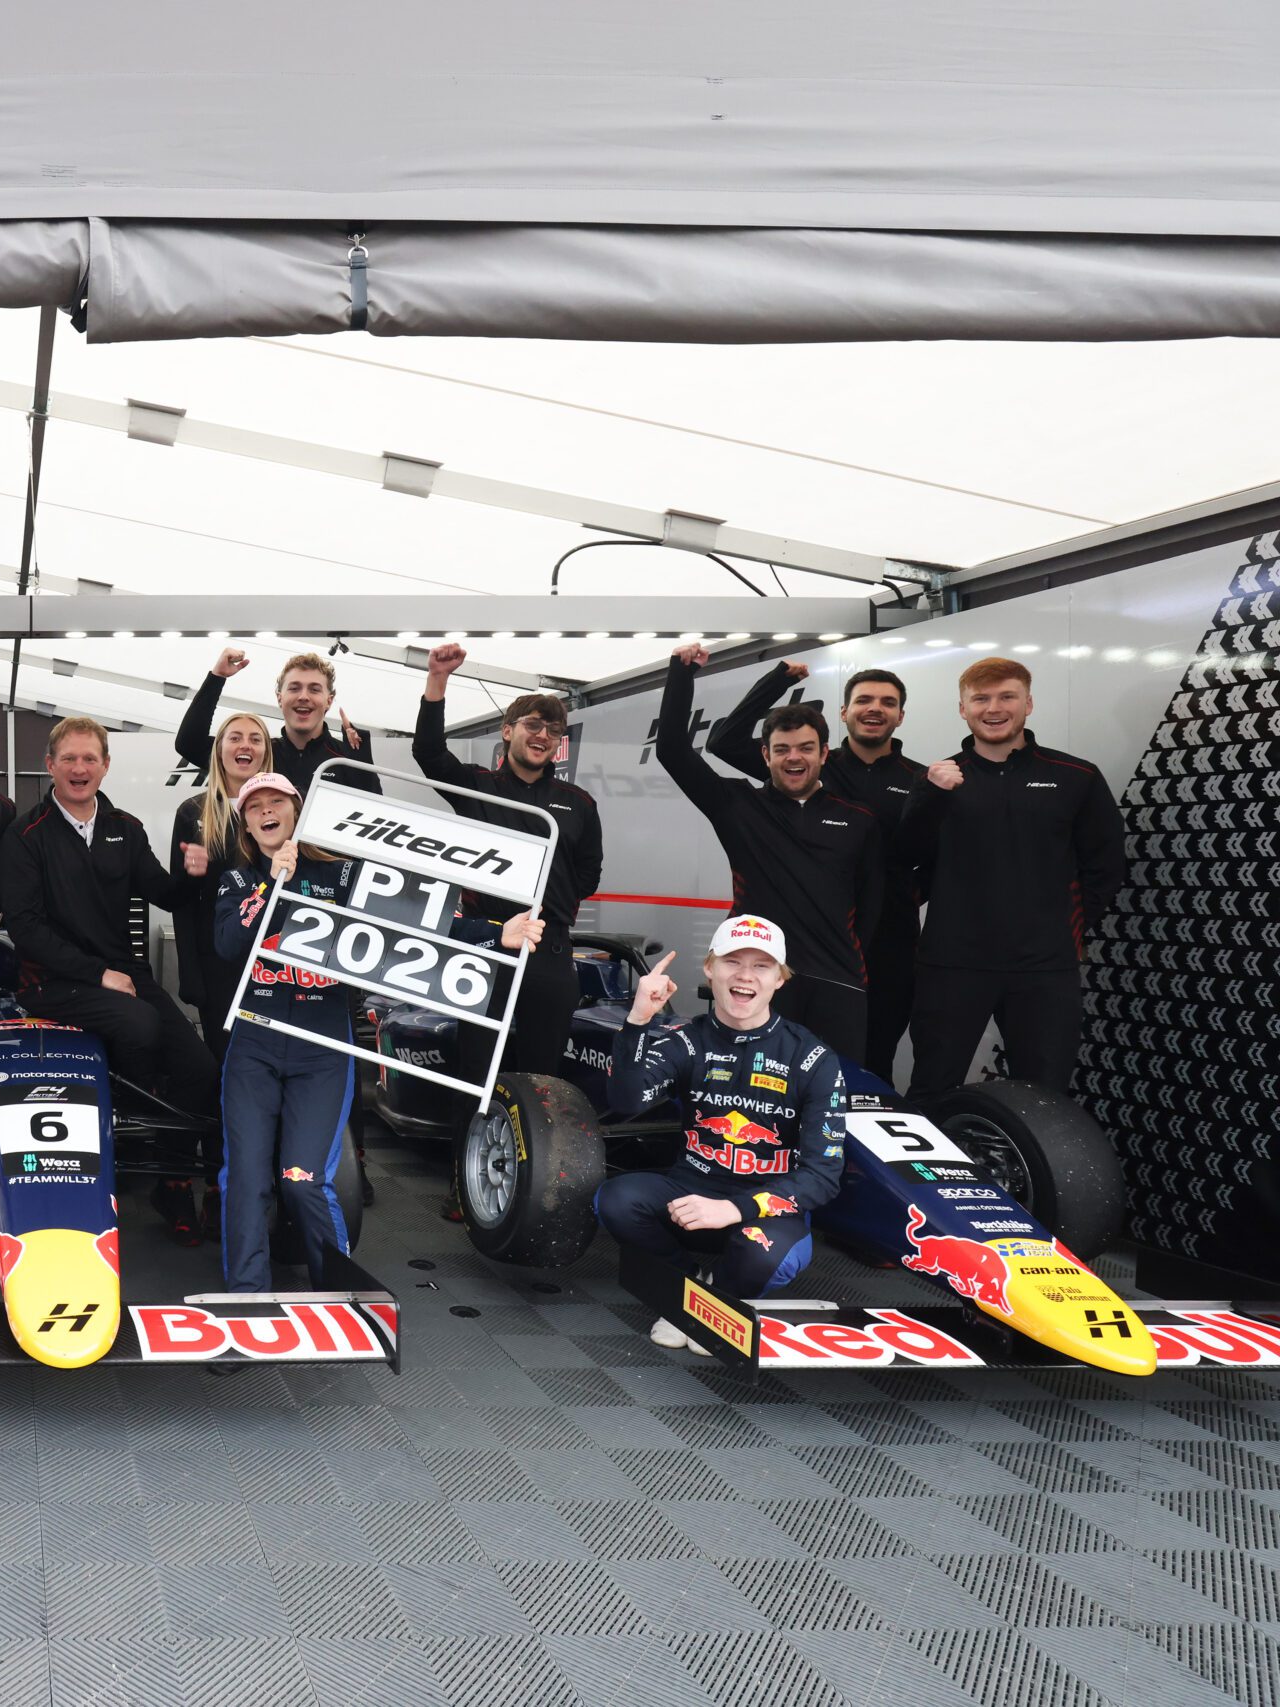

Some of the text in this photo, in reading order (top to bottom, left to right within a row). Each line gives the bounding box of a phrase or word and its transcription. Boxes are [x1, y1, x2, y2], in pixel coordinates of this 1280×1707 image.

[549, 803, 572, 811] Hitech
[332, 811, 514, 877] Hitech
[731, 930, 772, 942] Red Bull
[280, 907, 492, 1007] 2026
[395, 1047, 446, 1067] Wera
[800, 1046, 827, 1073] sparco
[11, 1072, 79, 1080] motorsport
[30, 1086, 67, 1094] F4
[850, 1095, 880, 1103] F4
[703, 1094, 796, 1119] ARROWHEAD
[30, 1111, 69, 1142] 6
[874, 1121, 935, 1152] 5
[684, 1130, 732, 1170] Red
[733, 1149, 791, 1175] Bull
[39, 1158, 81, 1168] Wera
[930, 1167, 975, 1178] Wera
[8, 1175, 97, 1185] #TEAMWILL37
[937, 1188, 1001, 1200] sparco
[1019, 1266, 1081, 1275] can-am
[1060, 1286, 1082, 1294] Falu
[1067, 1294, 1112, 1302] kommun
[689, 1289, 745, 1347] PIRELLI
[132, 1303, 380, 1357] Bull
